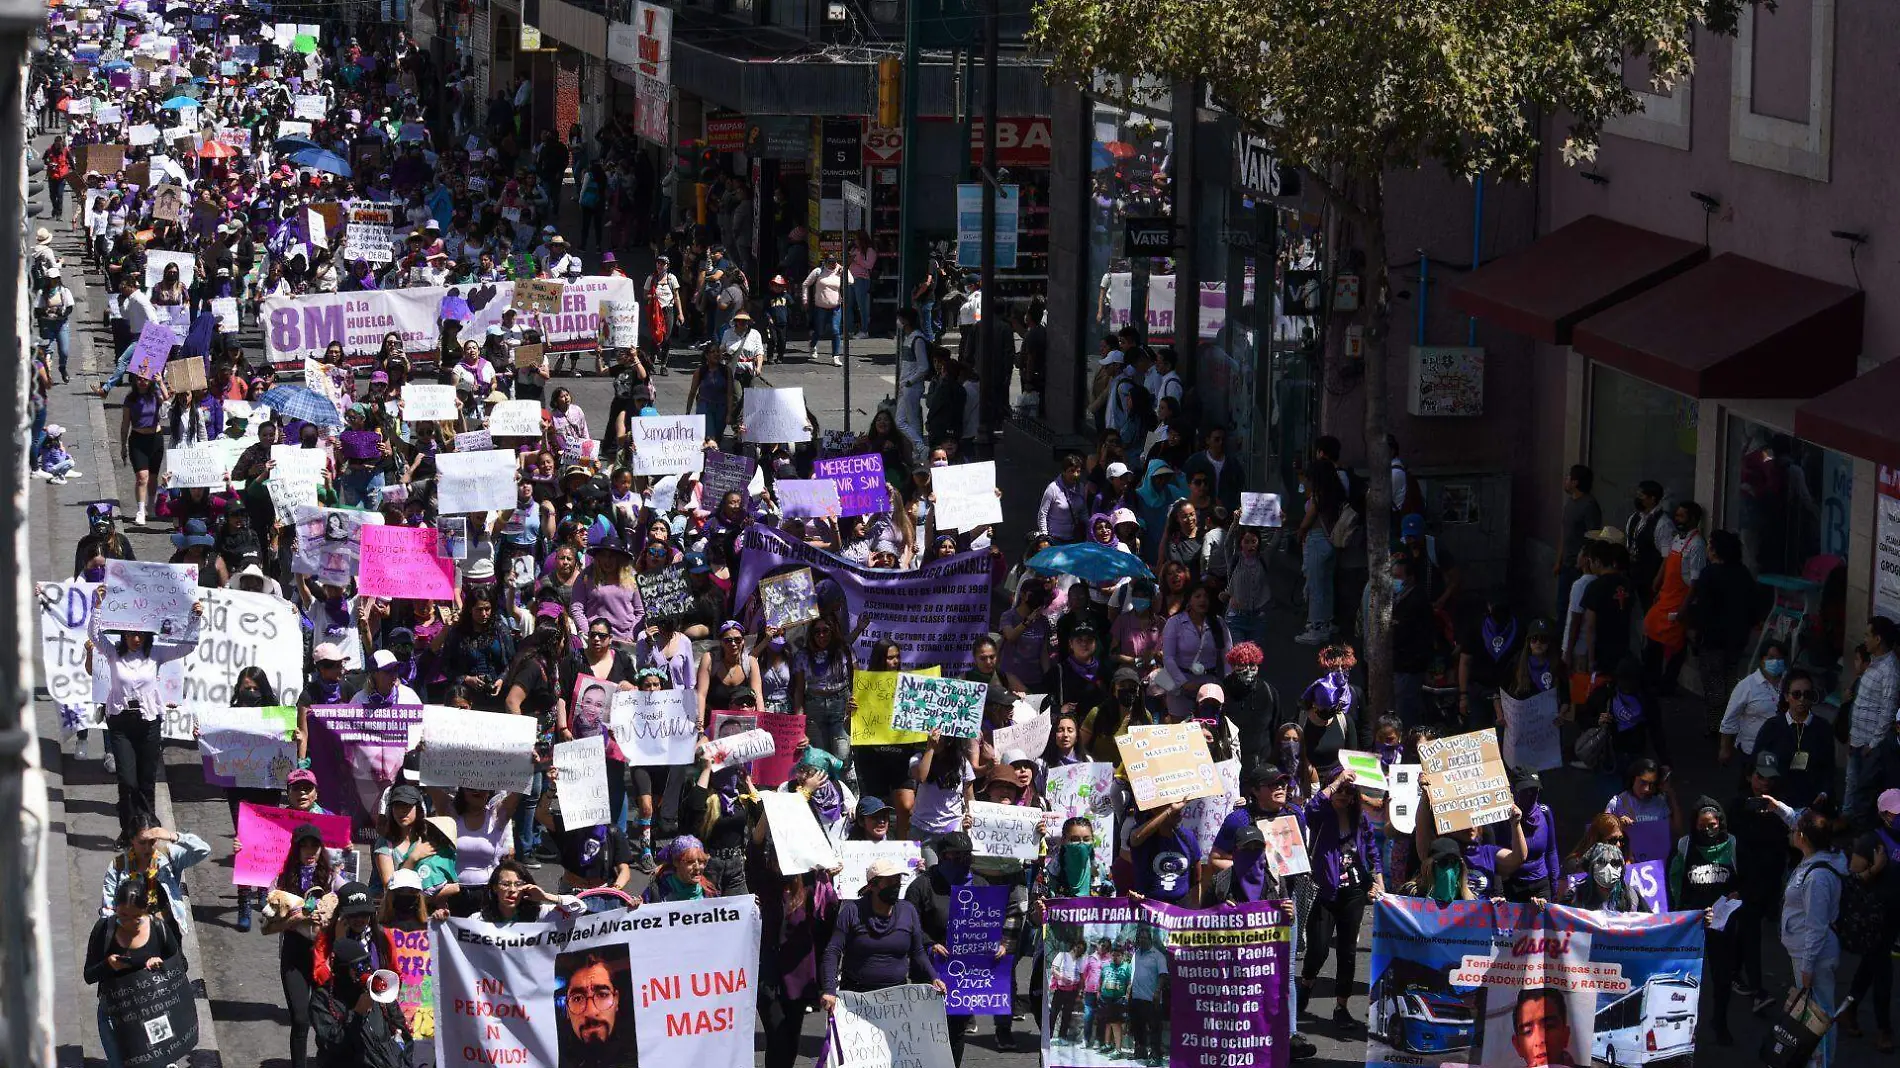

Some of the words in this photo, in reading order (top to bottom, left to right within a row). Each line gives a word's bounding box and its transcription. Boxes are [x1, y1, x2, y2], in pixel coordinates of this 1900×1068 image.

[837, 150, 847, 162] 5
[1237, 132, 1281, 197] VANS
[1130, 229, 1170, 246] VANS
[346, 301, 354, 312] A
[356, 300, 369, 312] la
[270, 305, 346, 353] 8M
[347, 315, 395, 329] HUELGA
[640, 419, 694, 442] Samantha
[820, 456, 882, 477] MERECEMOS
[861, 475, 880, 489] SIN
[744, 528, 790, 558] JUSTICIA
[113, 585, 126, 595] EL
[933, 585, 955, 594] JUNIO
[108, 599, 128, 613] QUE
[239, 611, 278, 640] es
[921, 614, 945, 624] CLASES
[899, 675, 937, 693] Nunca
[942, 683, 968, 697] creas
[898, 691, 918, 704] que
[936, 695, 971, 711] abuso
[356, 708, 364, 719] DE
[374, 709, 391, 719] CASA
[392, 709, 399, 719] EL
[399, 709, 407, 719] 30
[408, 709, 417, 719] DE
[901, 706, 920, 718] que
[924, 707, 971, 722] sufriste
[327, 721, 335, 731] DE
[365, 721, 387, 731] MISMO
[400, 721, 407, 731] LA
[1117, 737, 1132, 746] SOY
[1136, 740, 1148, 748] LA
[1419, 739, 1444, 760] Para
[1446, 736, 1466, 754] que
[1467, 736, 1480, 749] los
[1145, 745, 1189, 757] MAESTRAS
[1130, 763, 1147, 771] QUE
[1430, 758, 1443, 772] de
[1159, 785, 1202, 797] REGRESAR
[1433, 788, 1445, 798] se
[1434, 800, 1457, 813] como
[1459, 794, 1491, 812] dagas
[1496, 790, 1508, 801] en
[973, 817, 988, 828] DE
[995, 819, 1023, 831] VIEJA
[1440, 819, 1452, 832] la
[971, 830, 986, 841] NO
[991, 831, 1010, 843] POR
[1015, 833, 1034, 845] SER
[971, 902, 985, 919] Por
[952, 918, 967, 931] que
[1102, 909, 1132, 921] PARA
[1151, 910, 1194, 929] FAMILIA
[1196, 915, 1244, 929] TORRES
[1247, 910, 1281, 927] BELLO
[456, 928, 542, 951] Ezequiel
[546, 926, 595, 949] Rafael
[597, 914, 663, 936] Alvarez
[668, 907, 740, 927] Peralta
[953, 932, 960, 945] y
[962, 932, 988, 940] nunca
[1237, 946, 1277, 961] Paola,
[1177, 965, 1219, 978] Mateo
[1222, 966, 1230, 979] y
[1233, 962, 1275, 977] Rafael
[1466, 959, 1515, 970] Teniendo
[1593, 966, 1602, 974] a
[1603, 967, 1617, 976] un
[641, 976, 680, 1008] ¡NI
[692, 967, 747, 997] UNA
[956, 978, 993, 988] VIVIR
[1571, 980, 1578, 990] y
[1580, 978, 1627, 992] RATERO
[874, 991, 894, 1005] DE
[1195, 1000, 1239, 1014] Estado
[1242, 1000, 1259, 1013] de
[666, 1007, 734, 1038] MAS!
[871, 1026, 882, 1044] 8
[1181, 1033, 1198, 1047] 25
[1201, 1034, 1218, 1048] de
[1221, 1033, 1274, 1048] octubre
[897, 1040, 921, 1058] AL
[1200, 1053, 1217, 1066] de
[1220, 1052, 1254, 1066] 2020
